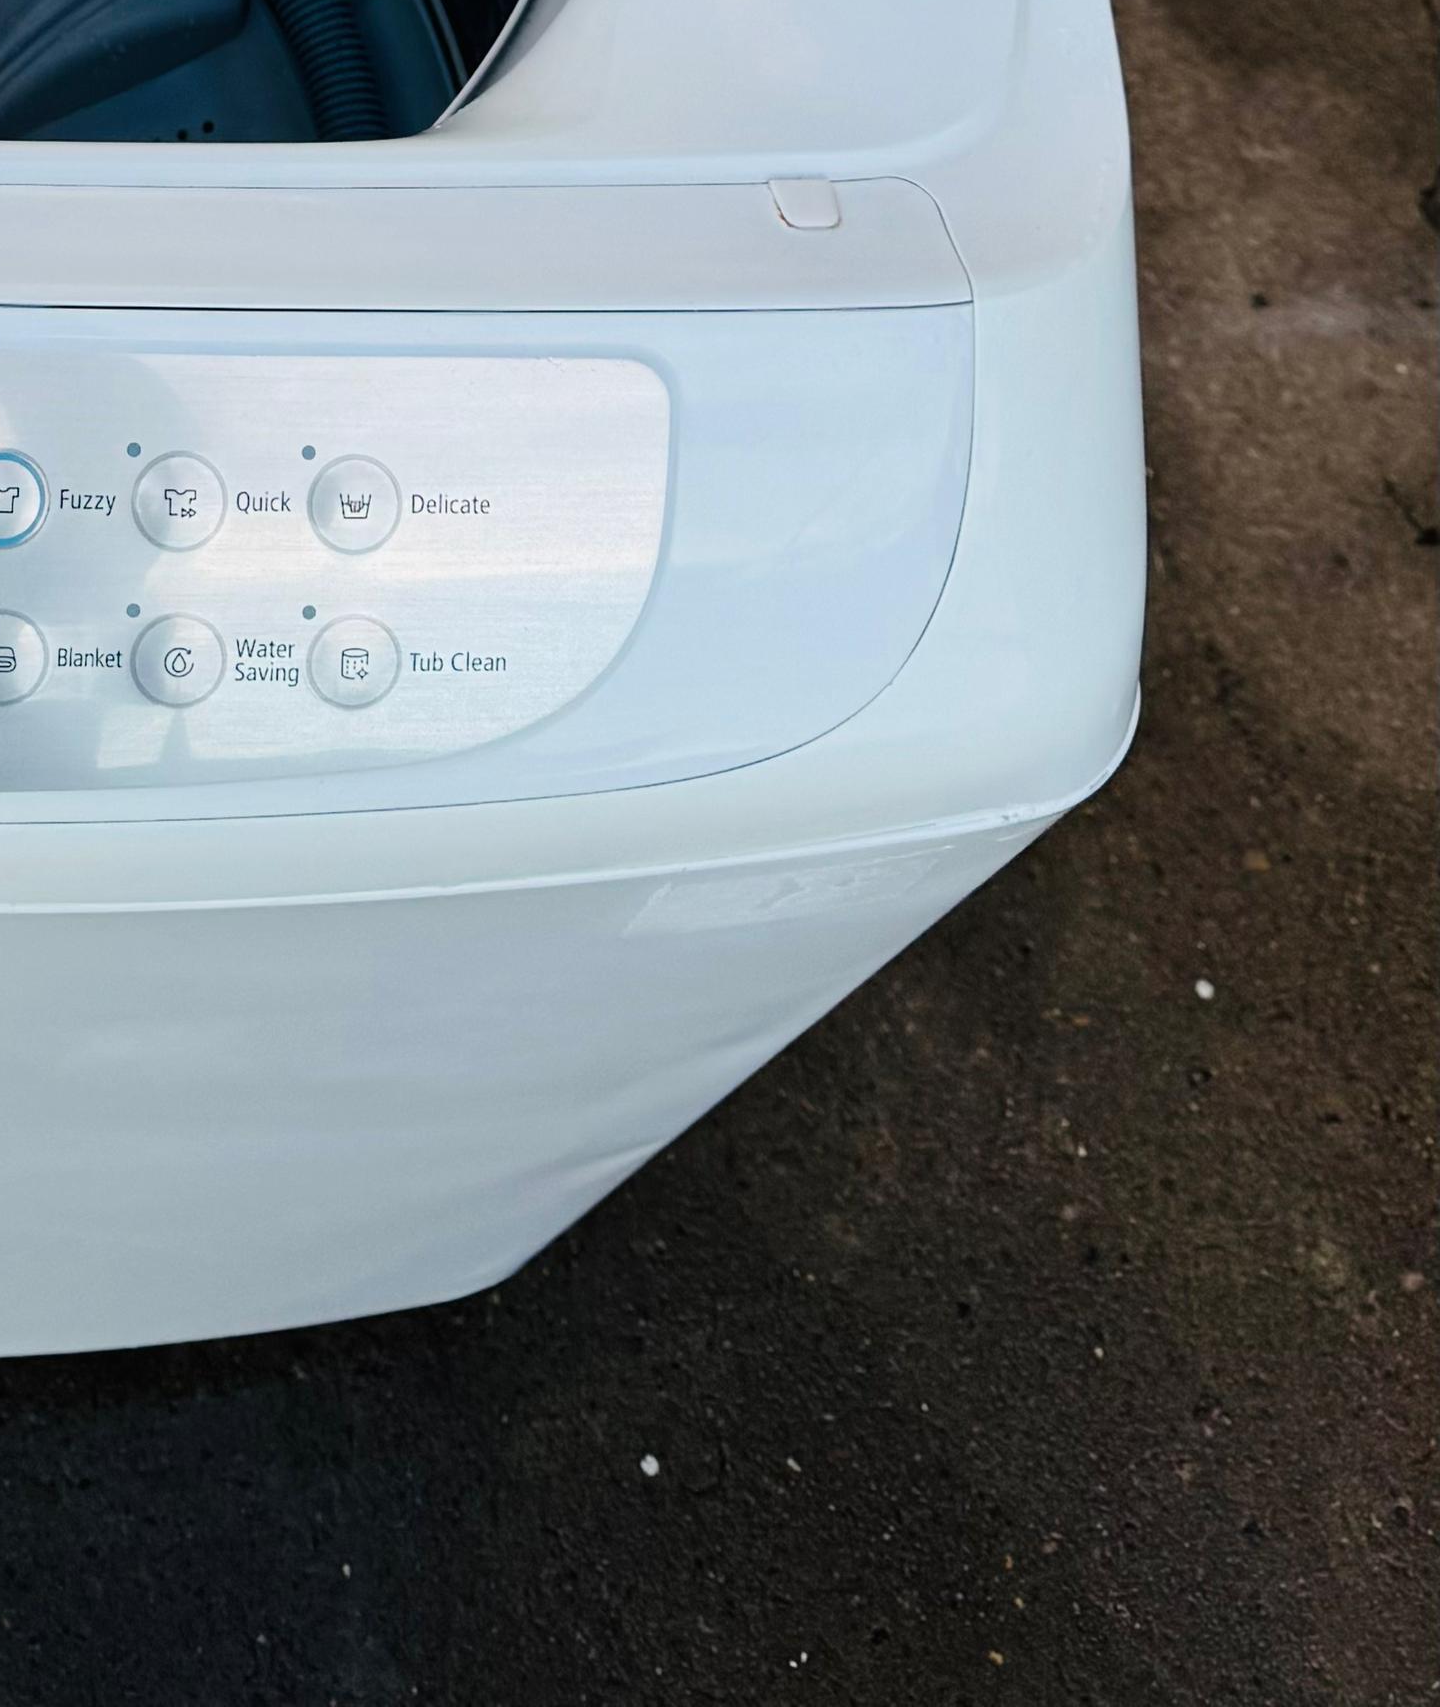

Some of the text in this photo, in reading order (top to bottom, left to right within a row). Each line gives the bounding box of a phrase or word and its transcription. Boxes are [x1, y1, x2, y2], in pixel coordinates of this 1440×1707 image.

[59, 489, 116, 516] Fuzzy
[236, 491, 292, 514] Quick
[411, 493, 490, 515] Delicate
[57, 647, 123, 669] Blanket
[236, 639, 296, 659] Water
[409, 651, 508, 673] Tub Clean
[234, 661, 300, 687] Saving
